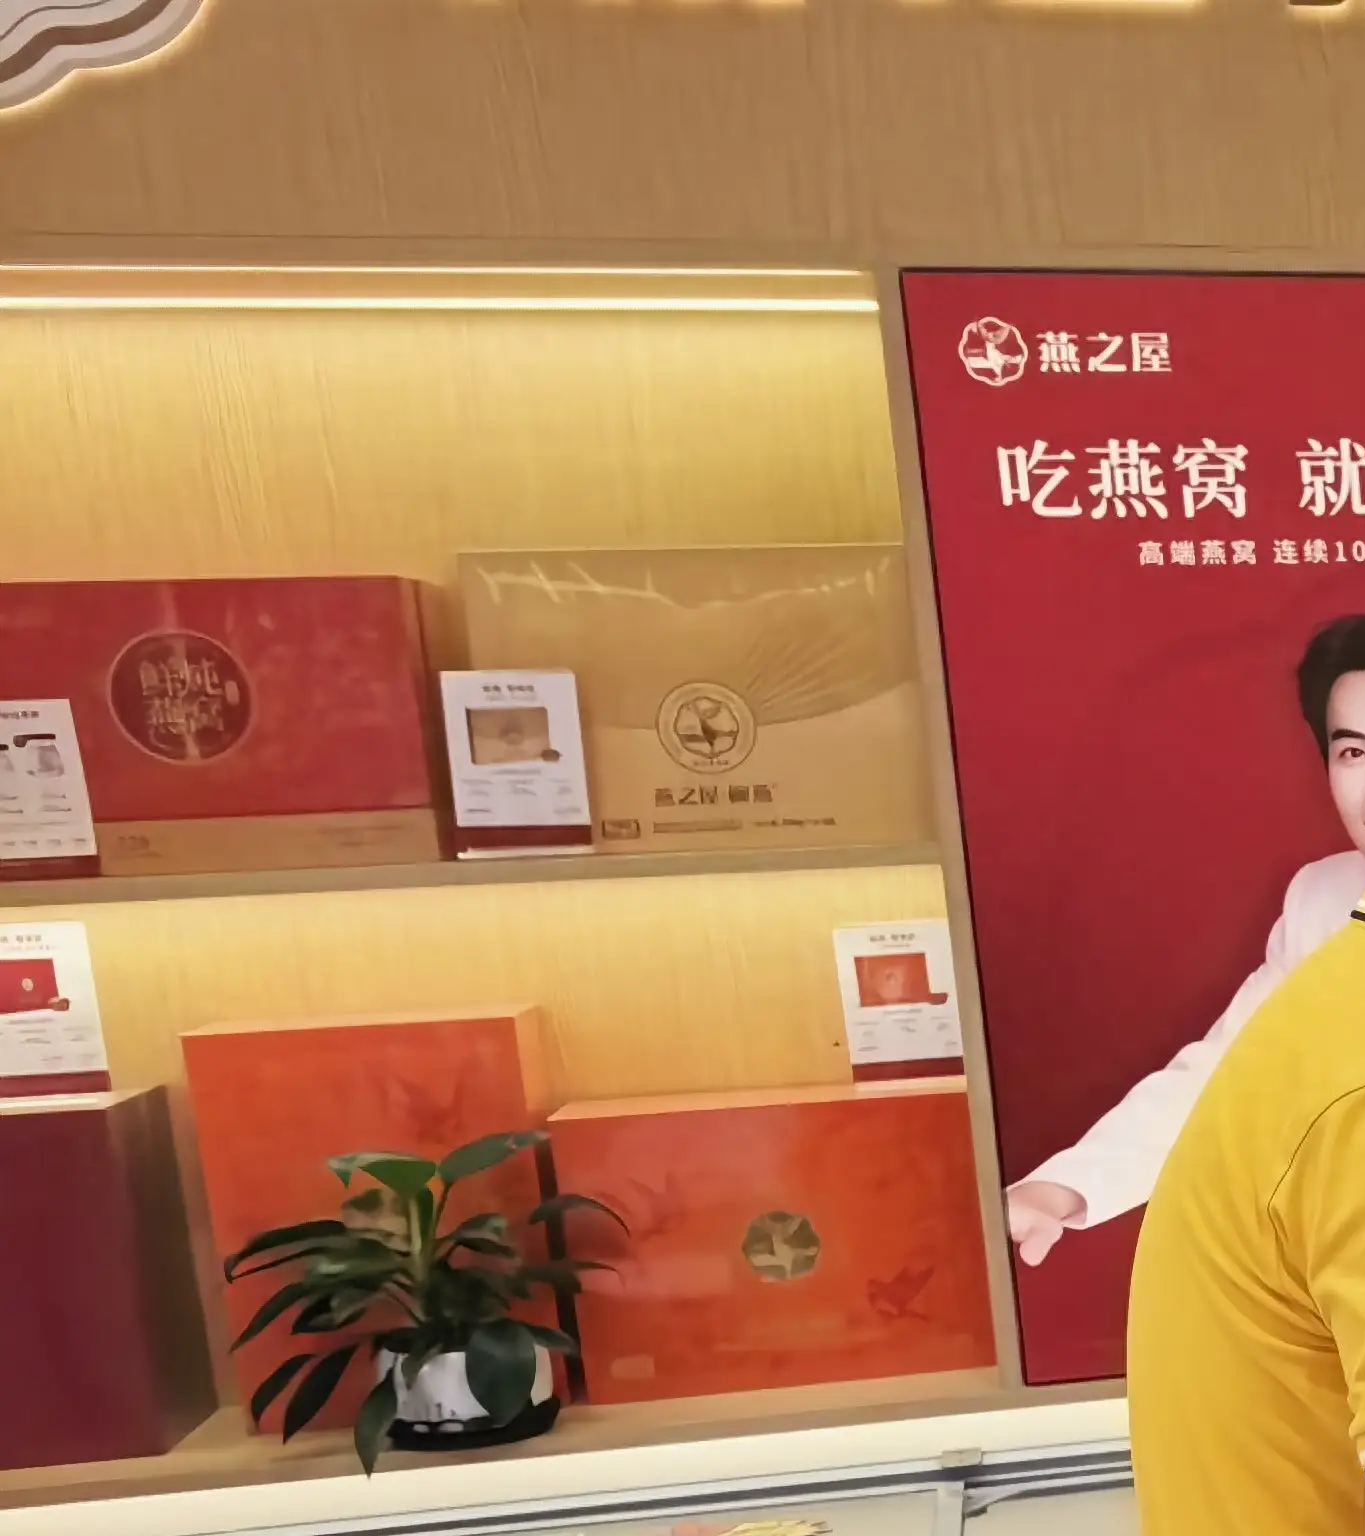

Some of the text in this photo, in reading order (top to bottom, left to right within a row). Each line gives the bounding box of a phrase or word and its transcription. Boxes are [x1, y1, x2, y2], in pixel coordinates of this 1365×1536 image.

[1035, 331, 1172, 373] 燕之屋
[996, 437, 1249, 520] 吃燕窝
[1137, 539, 1257, 566] 高端燕窝
